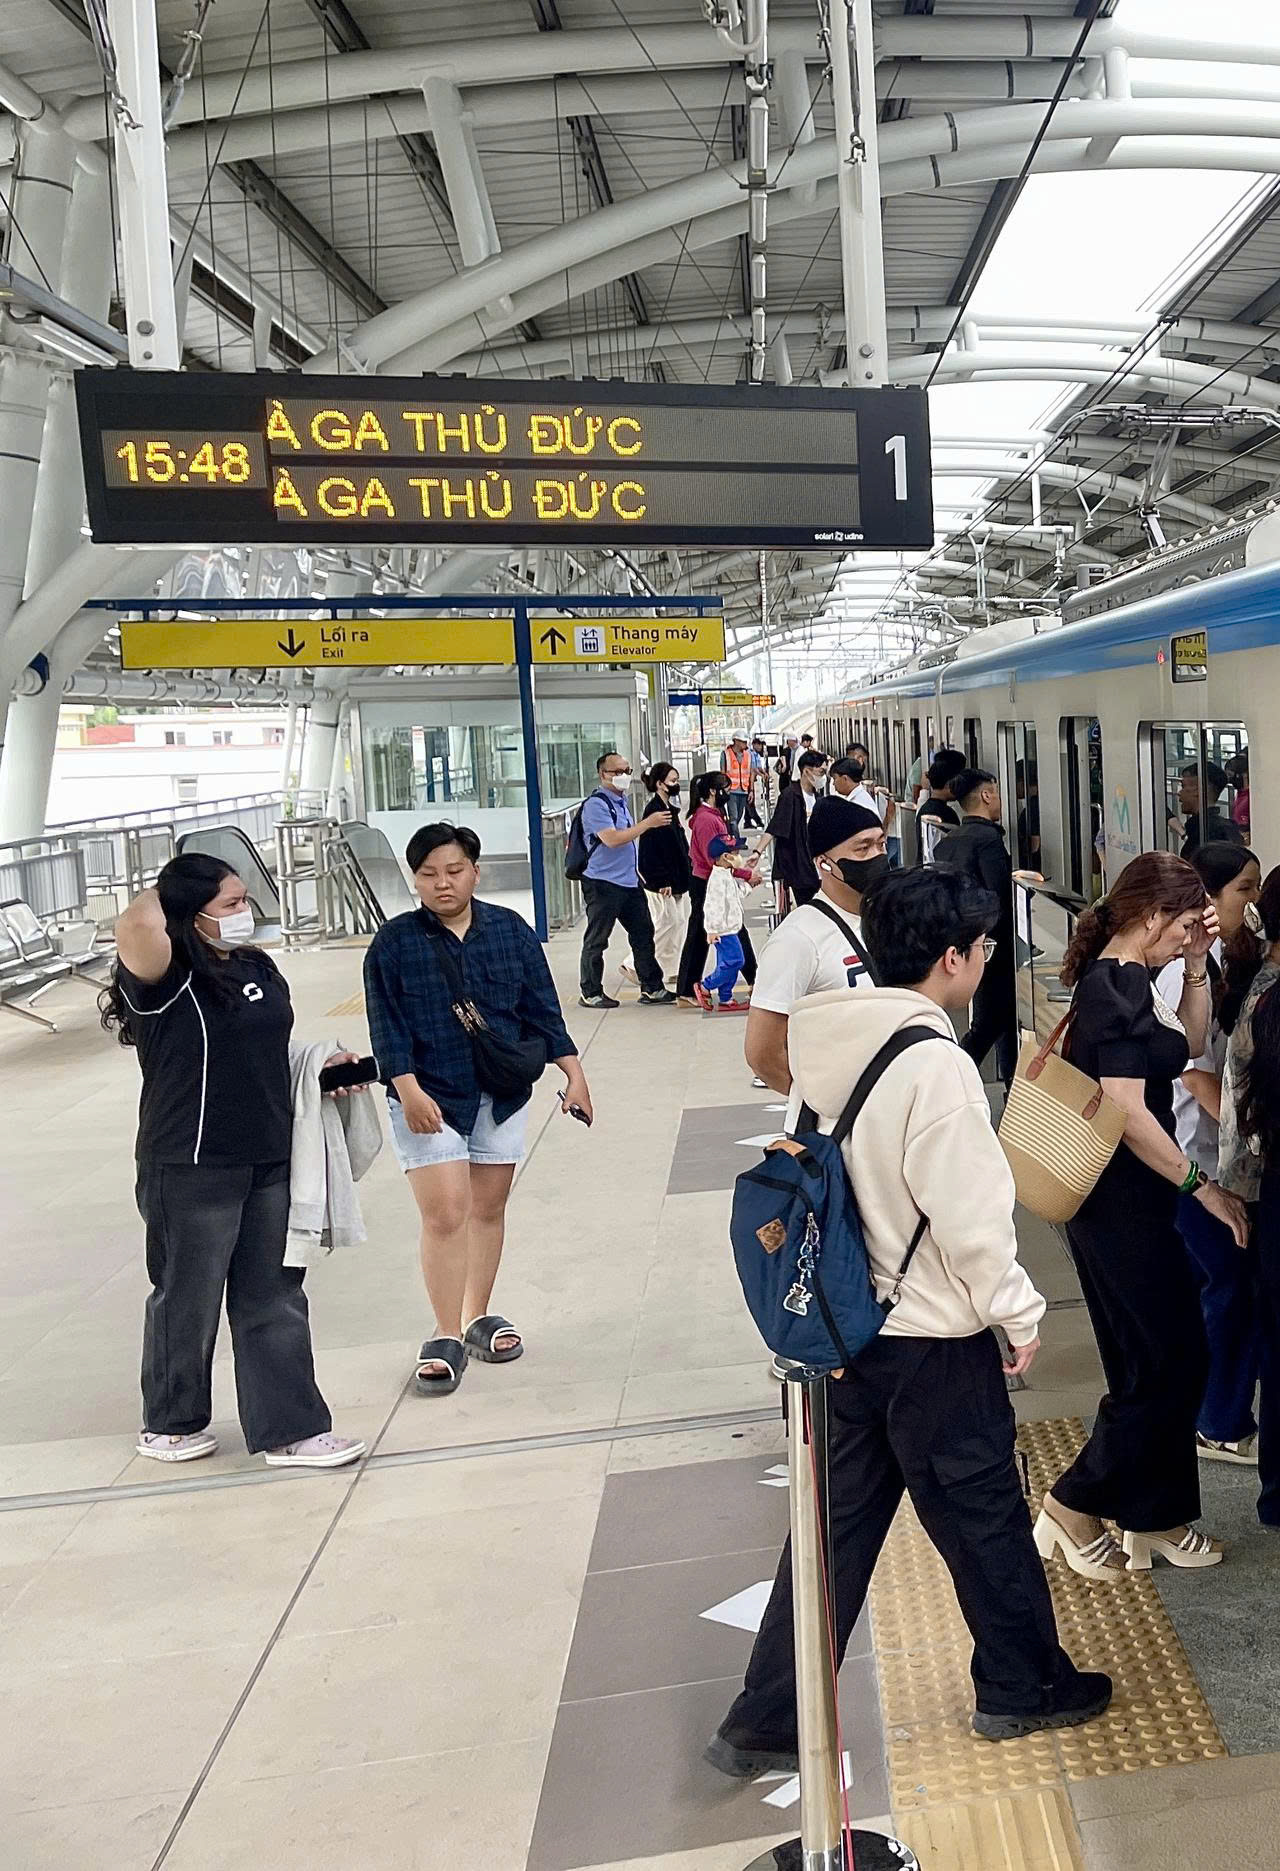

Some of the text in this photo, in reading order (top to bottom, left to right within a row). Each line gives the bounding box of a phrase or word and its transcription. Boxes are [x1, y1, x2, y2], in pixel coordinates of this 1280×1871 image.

[267, 400, 643, 456] À GA THỦ ĐỨC
[116, 441, 250, 483] 15:48
[884, 435, 908, 501] 1
[273, 466, 646, 520] À GA THỦ ĐỨC
[320, 626, 369, 642] Lối ra
[611, 625, 698, 642] Thang máy
[322, 647, 344, 658] Exit
[611, 645, 656, 655] Elevator
